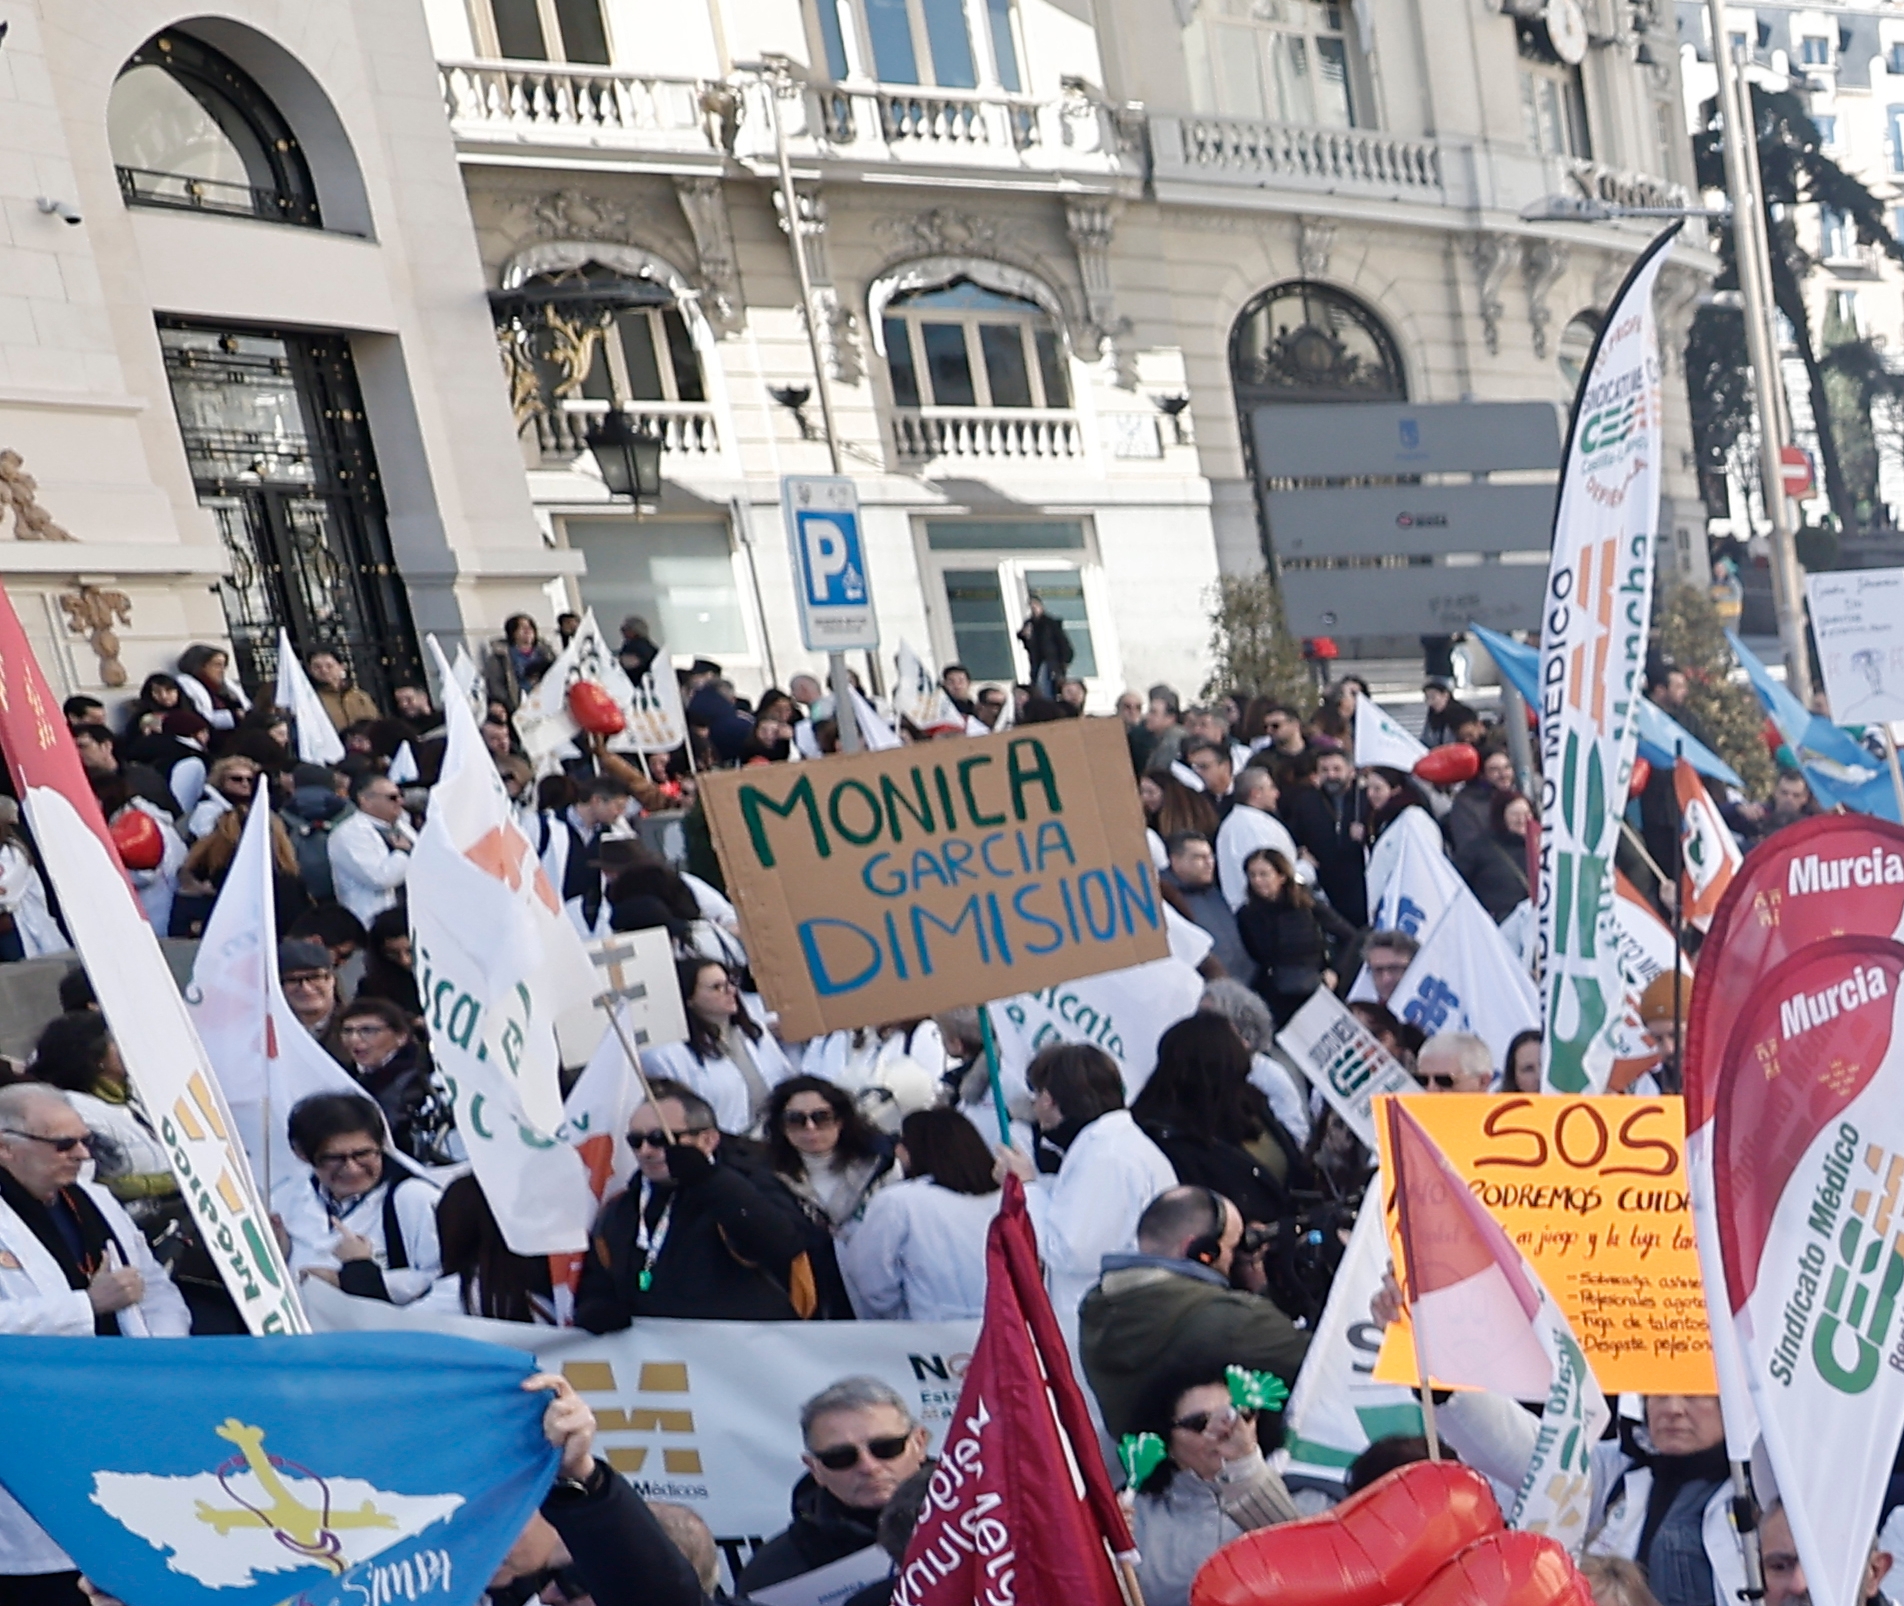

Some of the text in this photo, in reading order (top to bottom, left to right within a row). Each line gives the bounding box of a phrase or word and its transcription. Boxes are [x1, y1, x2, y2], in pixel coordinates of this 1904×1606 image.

[803, 518, 848, 601] P
[738, 736, 1063, 868] MONICA
[862, 820, 1076, 898] GARCIA
[797, 860, 1160, 996] DIMISION
[1778, 964, 1888, 1041] Murcia
[1474, 1099, 1679, 1177] SOS
[1468, 1180, 1602, 1216] PODREMOS
[1768, 1119, 1861, 1388] Sindicato Médico
[1582, 1310, 1614, 1336] Fuga
